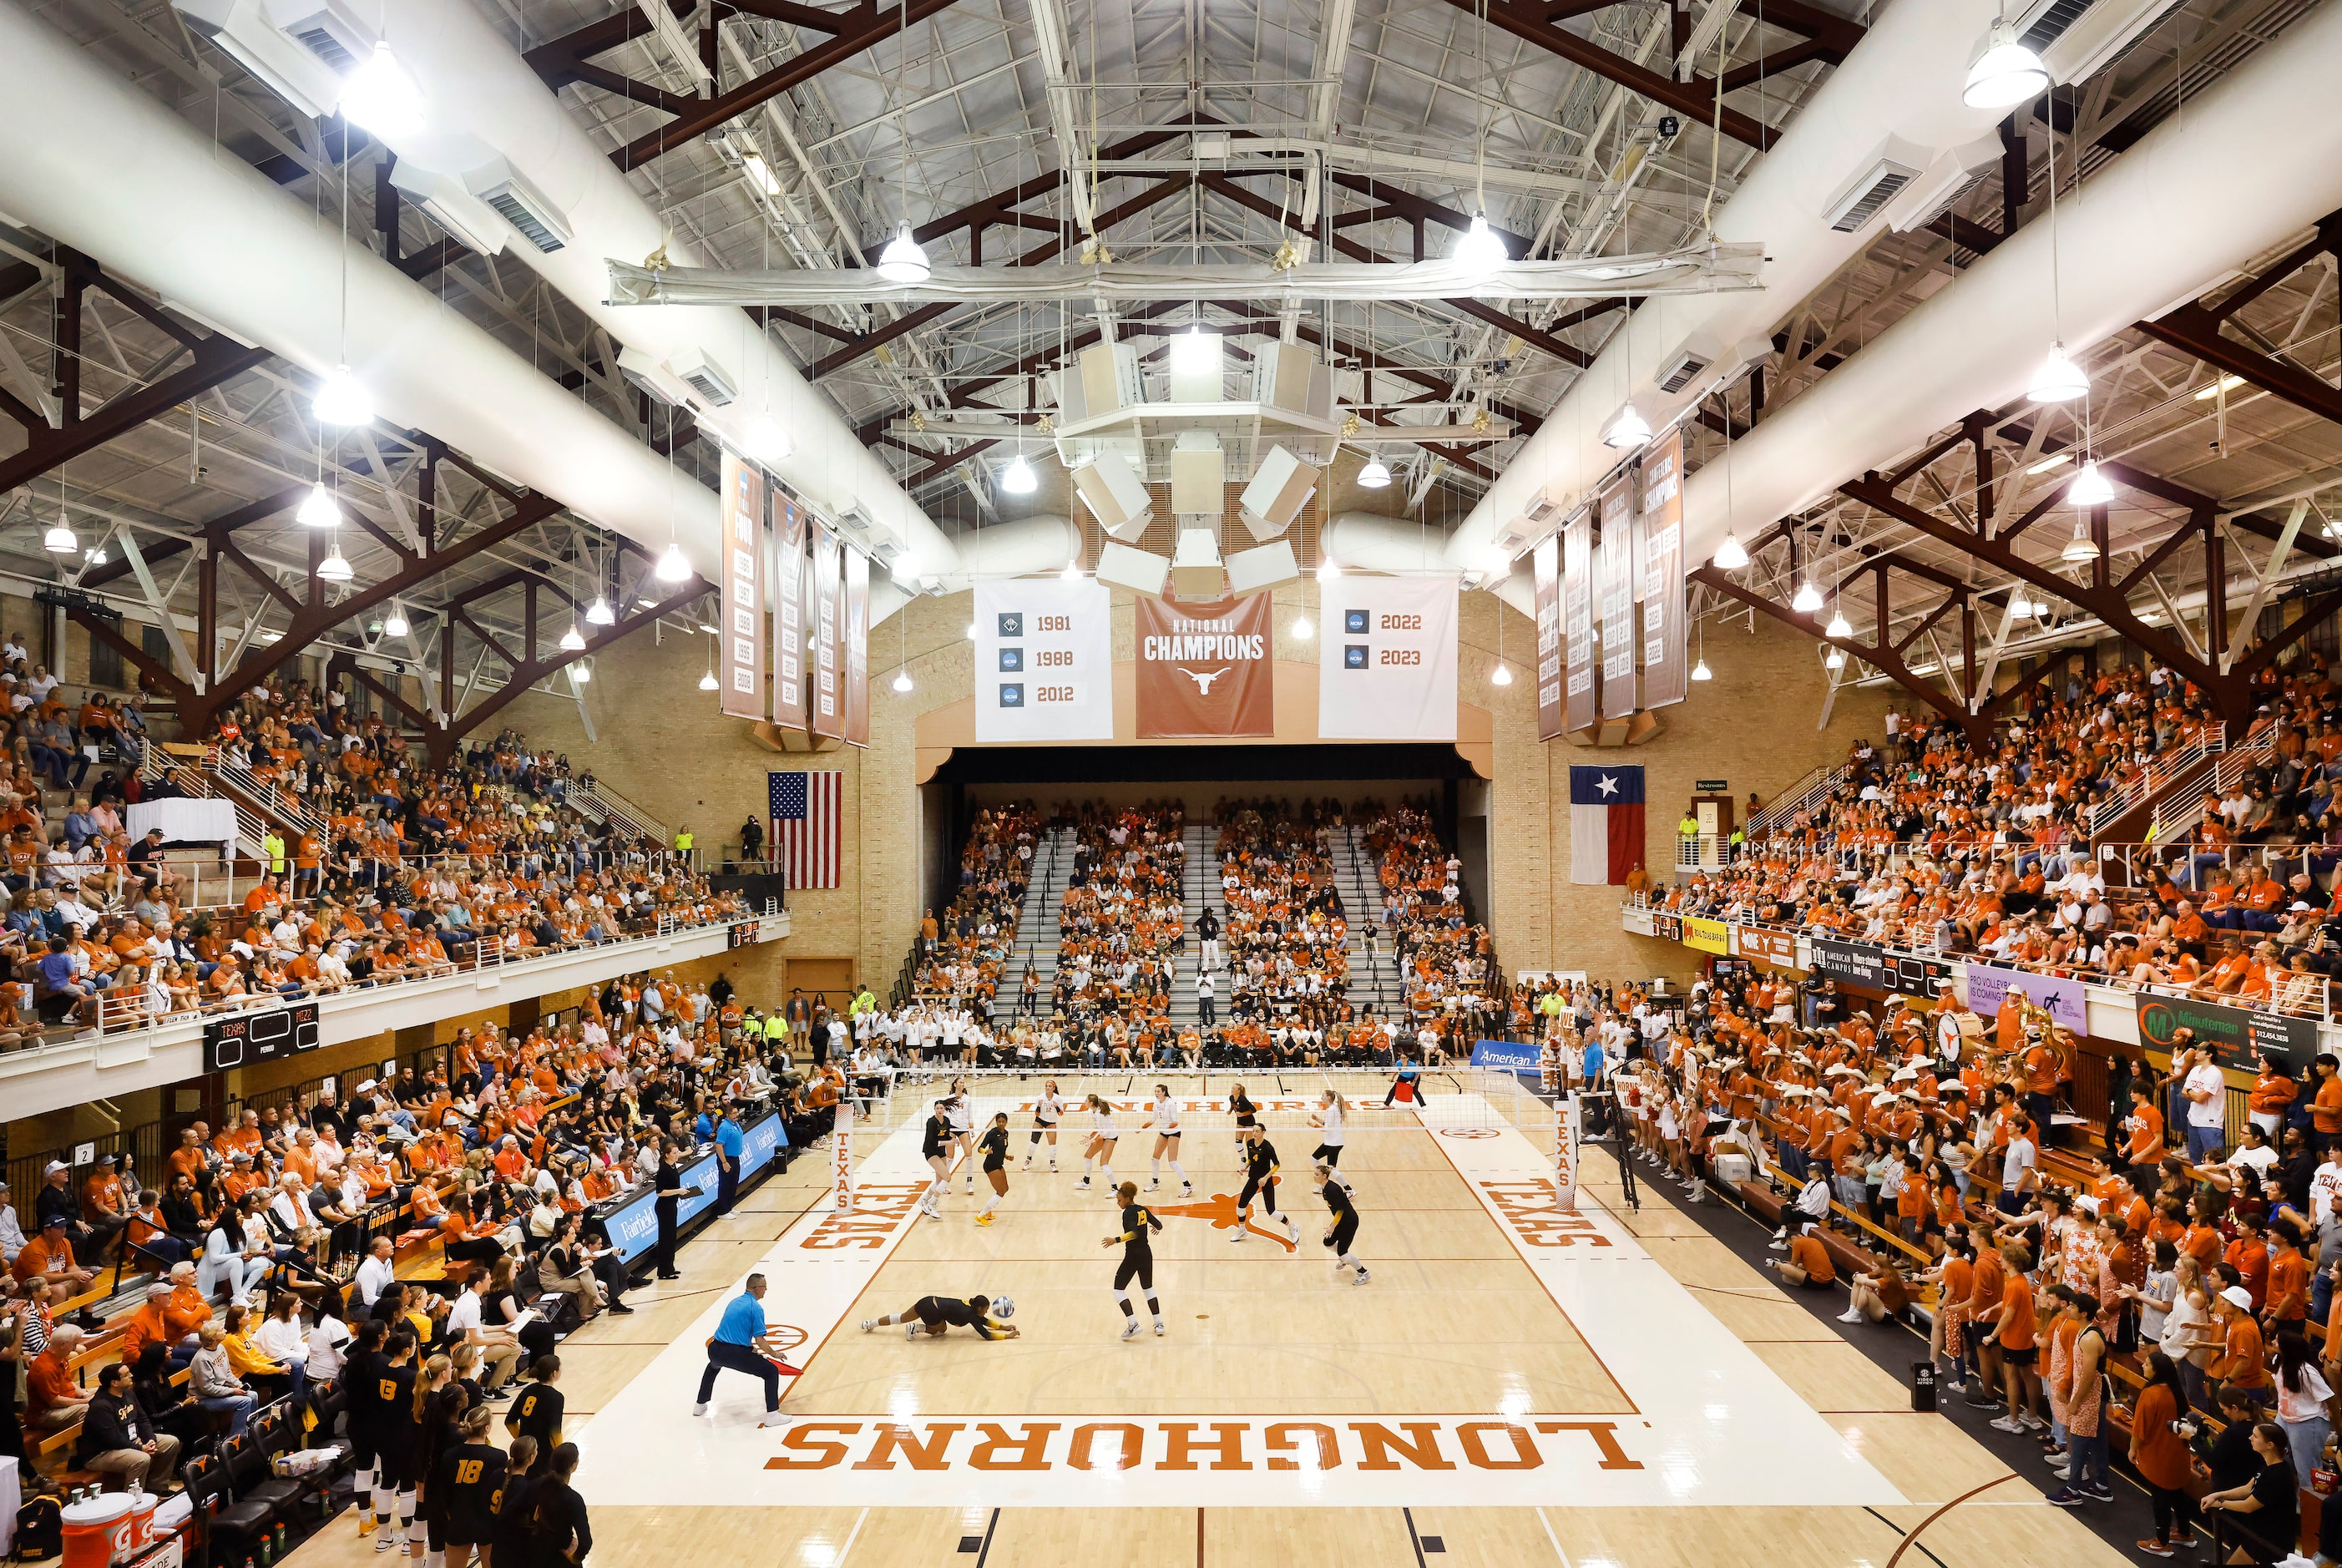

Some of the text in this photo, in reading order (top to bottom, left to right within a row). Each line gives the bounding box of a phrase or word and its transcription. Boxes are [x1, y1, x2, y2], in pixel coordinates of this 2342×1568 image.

[1645, 472, 1678, 515] CHAMPIONS
[735, 509, 753, 547] FOUR
[1037, 616, 1071, 631] 1981
[1381, 615, 1422, 630] 2022
[1648, 609, 1660, 627] 2021
[1173, 619, 1235, 634] NATIONAL
[1144, 635, 1264, 661] CHAMPIONS
[1648, 644, 1661, 661] 2022
[1036, 652, 1073, 666] 1988
[1381, 650, 1421, 665] 2023
[1037, 687, 1075, 701] 2012
[1827, 952, 1851, 963] AMERICAN
[1827, 961, 1851, 974] CAMPUS
[1970, 975, 1982, 986] PRO
[1970, 987, 1976, 997] IS
[1977, 989, 2001, 1002] COMING
[296, 1009, 312, 1023] MIZZ
[1560, 1012, 1574, 1026] WE
[2178, 1010, 2239, 1035] Minuteman
[221, 1022, 245, 1038] TEXAS
[2256, 1029, 2289, 1043] 512.454.3838
[260, 1044, 275, 1054] PERIOD
[1480, 1050, 1530, 1065] American
[756, 1125, 777, 1151] Fairfield
[82, 1151, 88, 1161] 2
[1555, 1110, 1571, 1186] TEXAS
[837, 1133, 849, 1208] TEXAS
[799, 1181, 933, 1249] TEXAS
[1137, 1210, 1147, 1226] 19
[1479, 1178, 1613, 1247] TEXAS
[620, 1206, 656, 1241] Fairfield
[379, 1378, 397, 1401] 13
[521, 1395, 537, 1417] 8
[763, 1422, 1646, 1470] LONGHORNS
[455, 1459, 484, 1484] 18
